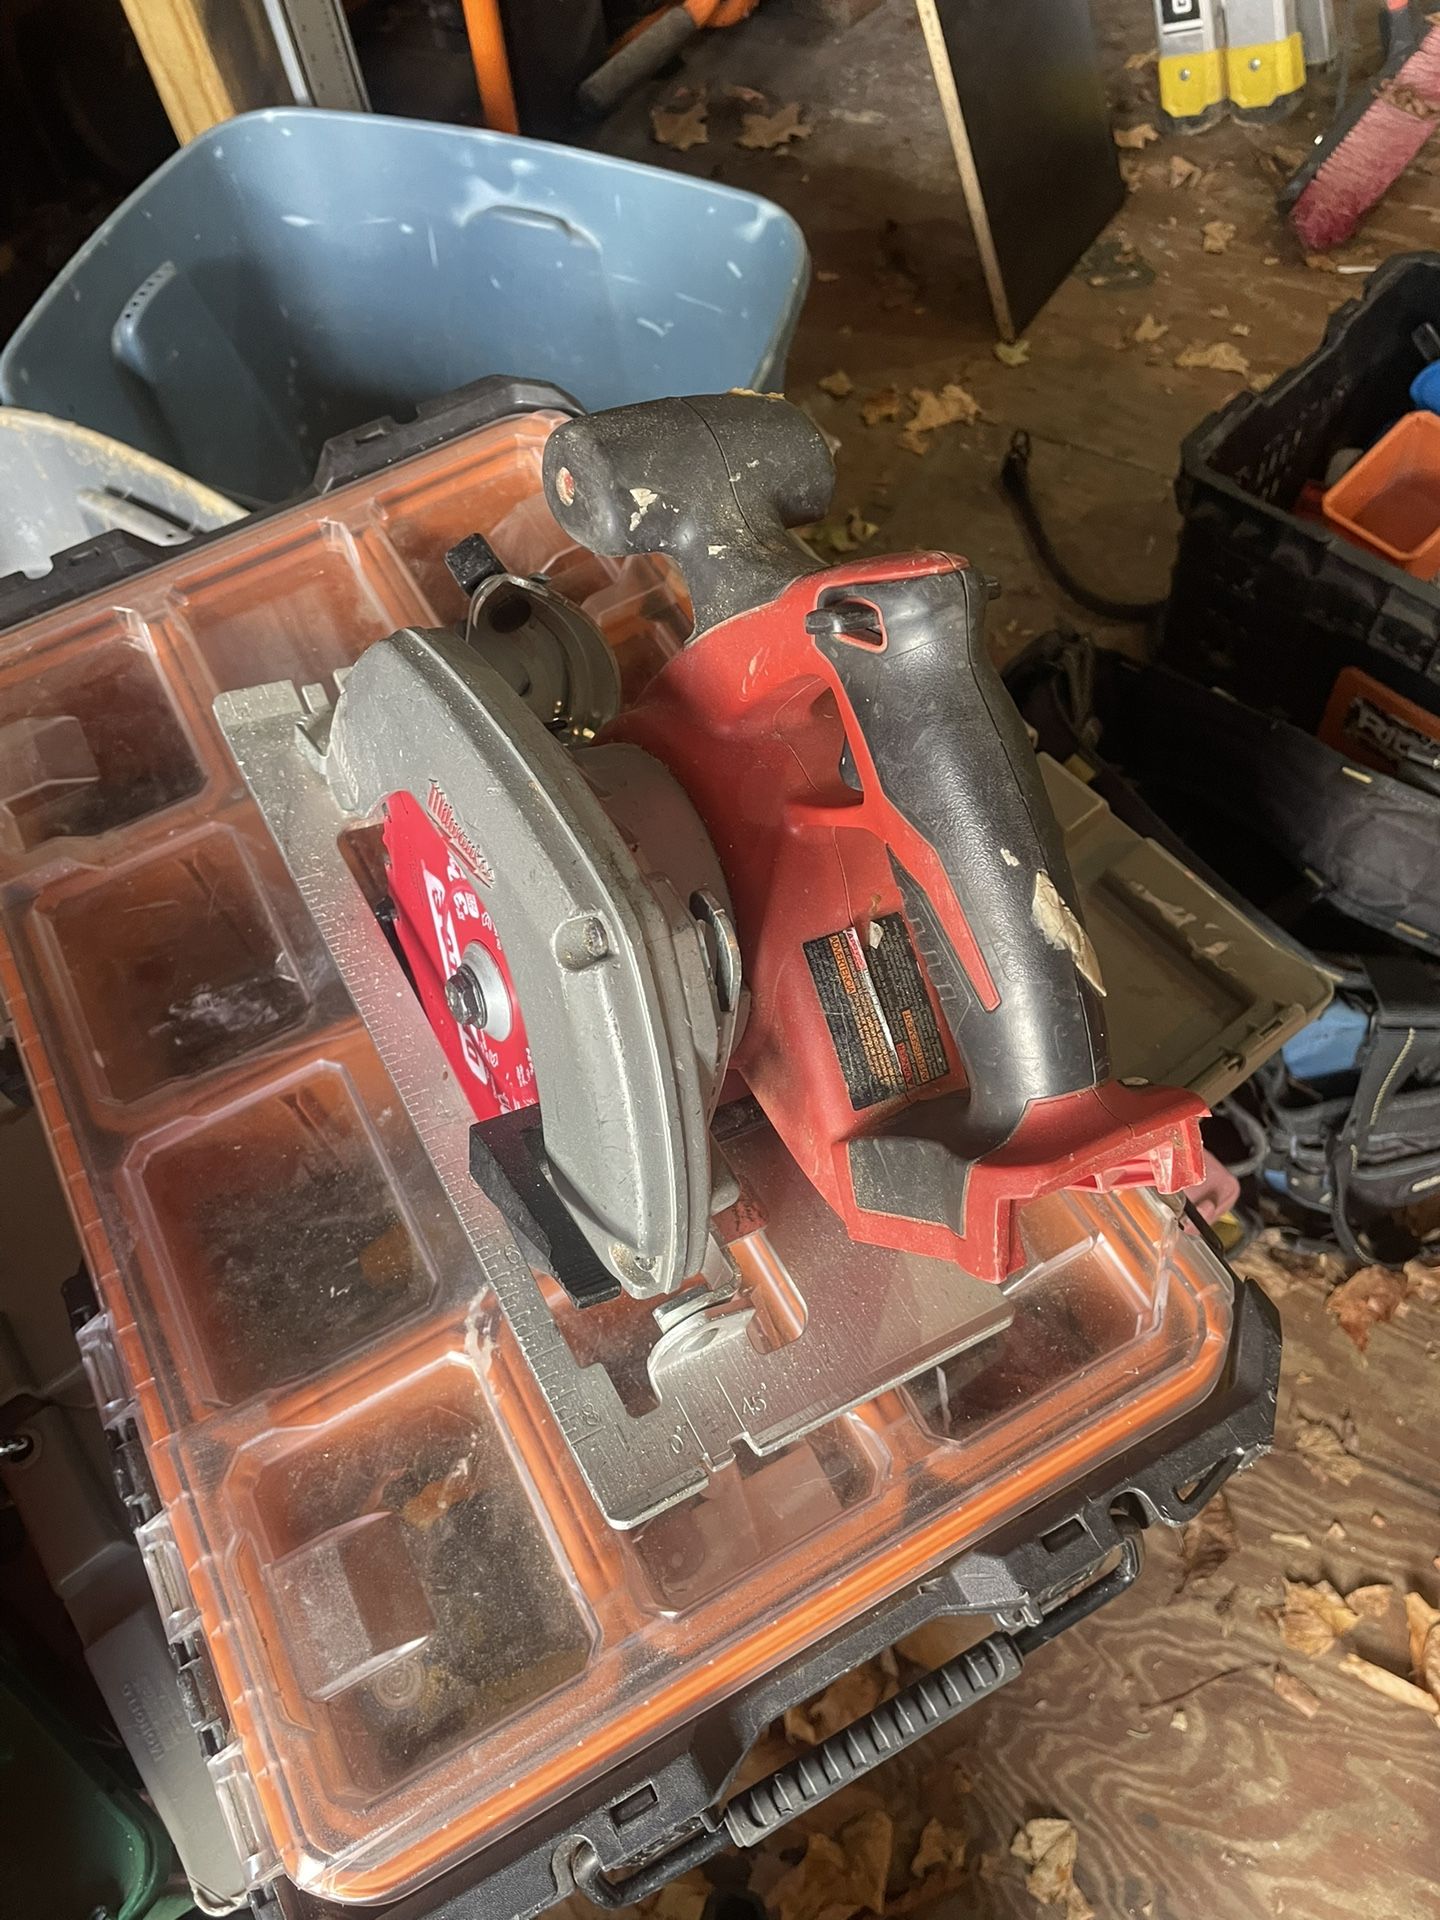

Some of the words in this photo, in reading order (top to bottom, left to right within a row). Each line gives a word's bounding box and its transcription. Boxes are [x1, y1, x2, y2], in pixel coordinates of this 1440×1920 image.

[829, 935, 855, 993] ADVERTENCIA
[901, 1011, 931, 1080] AVERTISSEMENT
[504, 1244, 521, 1264] 6
[581, 1402, 601, 1426] 8
